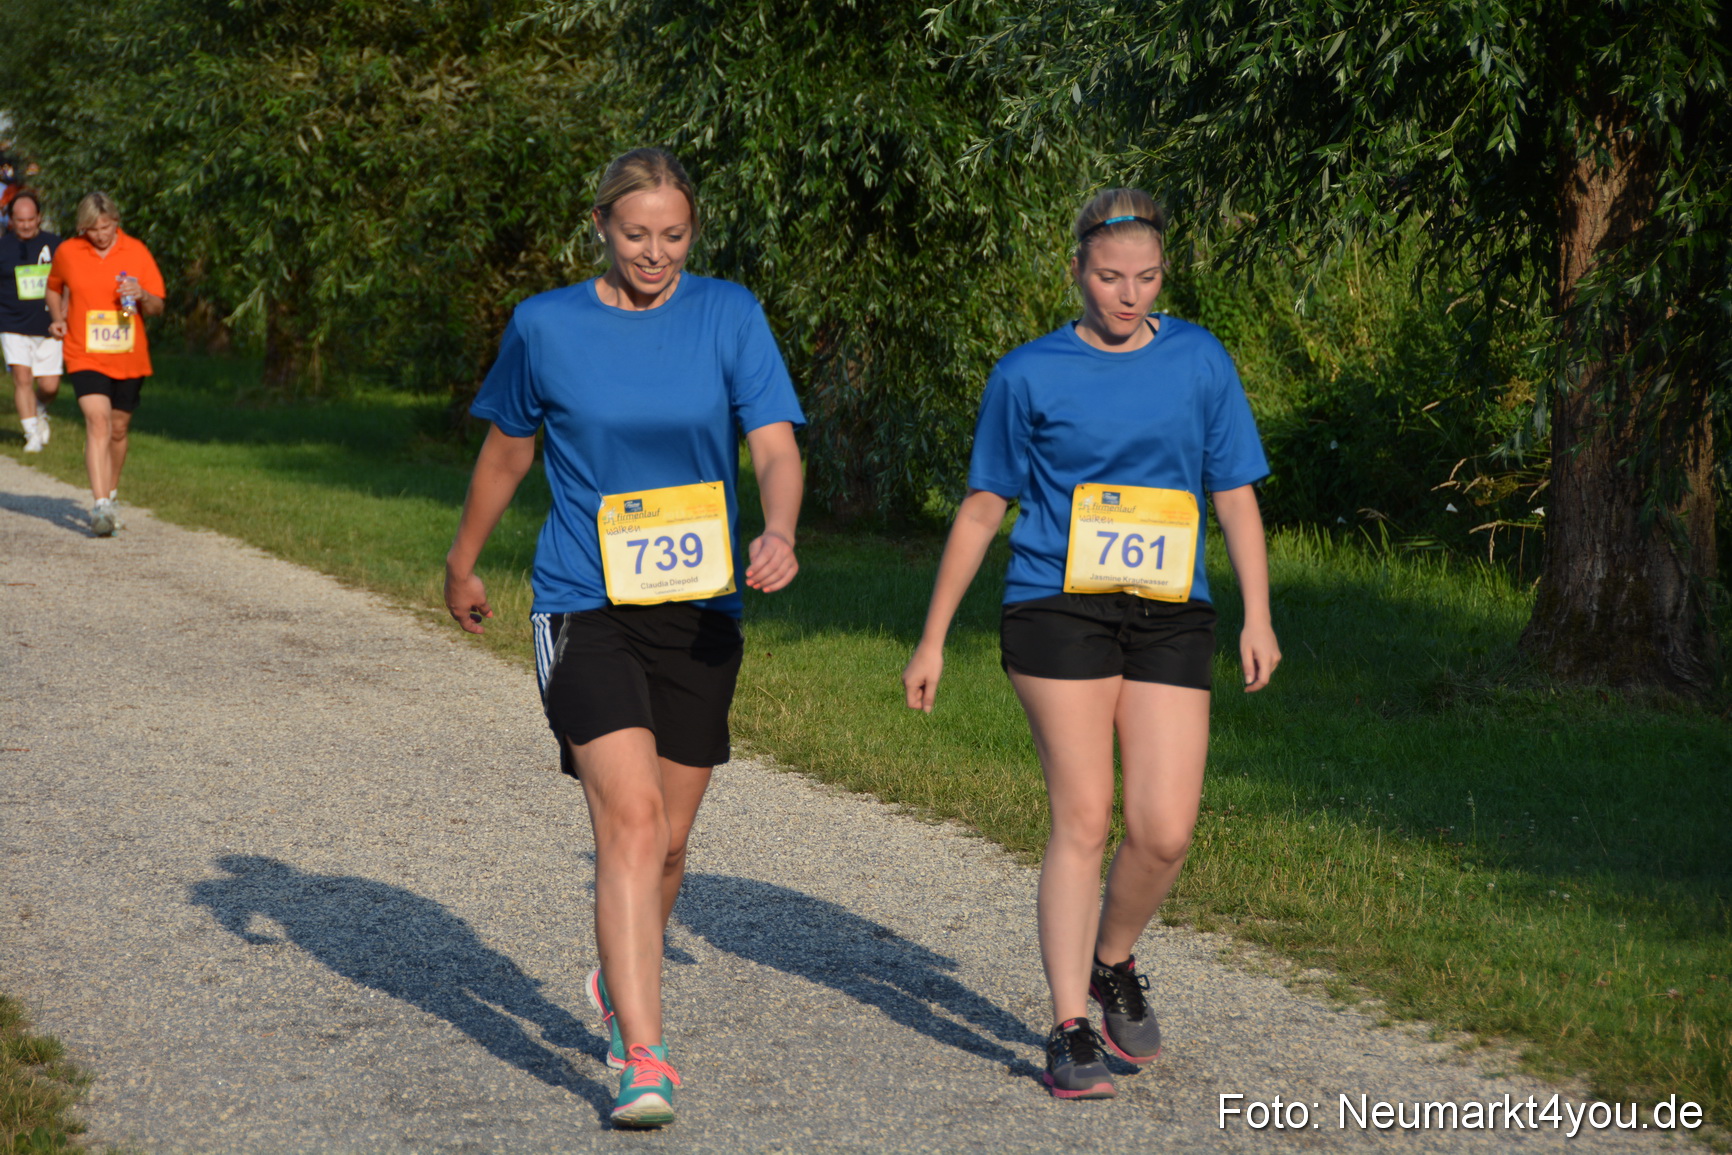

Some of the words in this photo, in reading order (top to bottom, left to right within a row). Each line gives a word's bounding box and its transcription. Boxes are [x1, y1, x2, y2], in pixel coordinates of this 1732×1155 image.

[93, 328, 129, 341] 1041
[1092, 502, 1136, 513] firmenlauf
[617, 508, 660, 521] firmenlauf
[626, 532, 703, 575] 739
[1096, 530, 1166, 570] 761
[640, 580, 668, 590] Claudia
[669, 576, 699, 587] Diepold
[1089, 573, 1122, 583] Jasmine
[1122, 576, 1169, 586] Krautwasser
